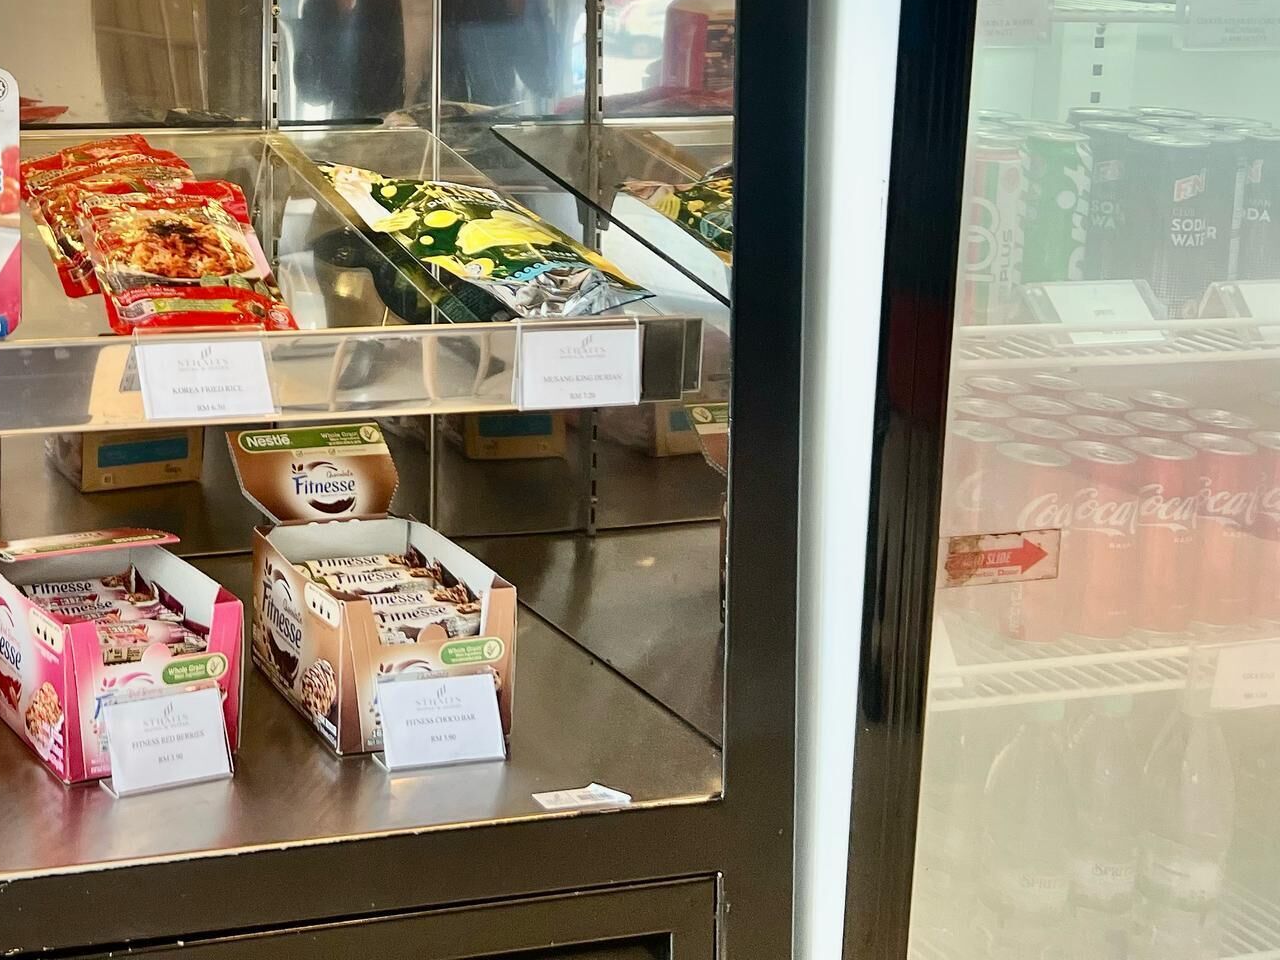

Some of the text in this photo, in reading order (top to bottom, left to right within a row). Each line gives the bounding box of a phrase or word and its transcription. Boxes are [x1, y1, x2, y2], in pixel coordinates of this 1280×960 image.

[1000, 230, 1013, 282] PLUS
[292, 476, 356, 495] Fitnesse
[985, 552, 1013, 565] SLIDE
[335, 569, 401, 586] Fitnesse
[262, 579, 302, 649] Fitnesse
